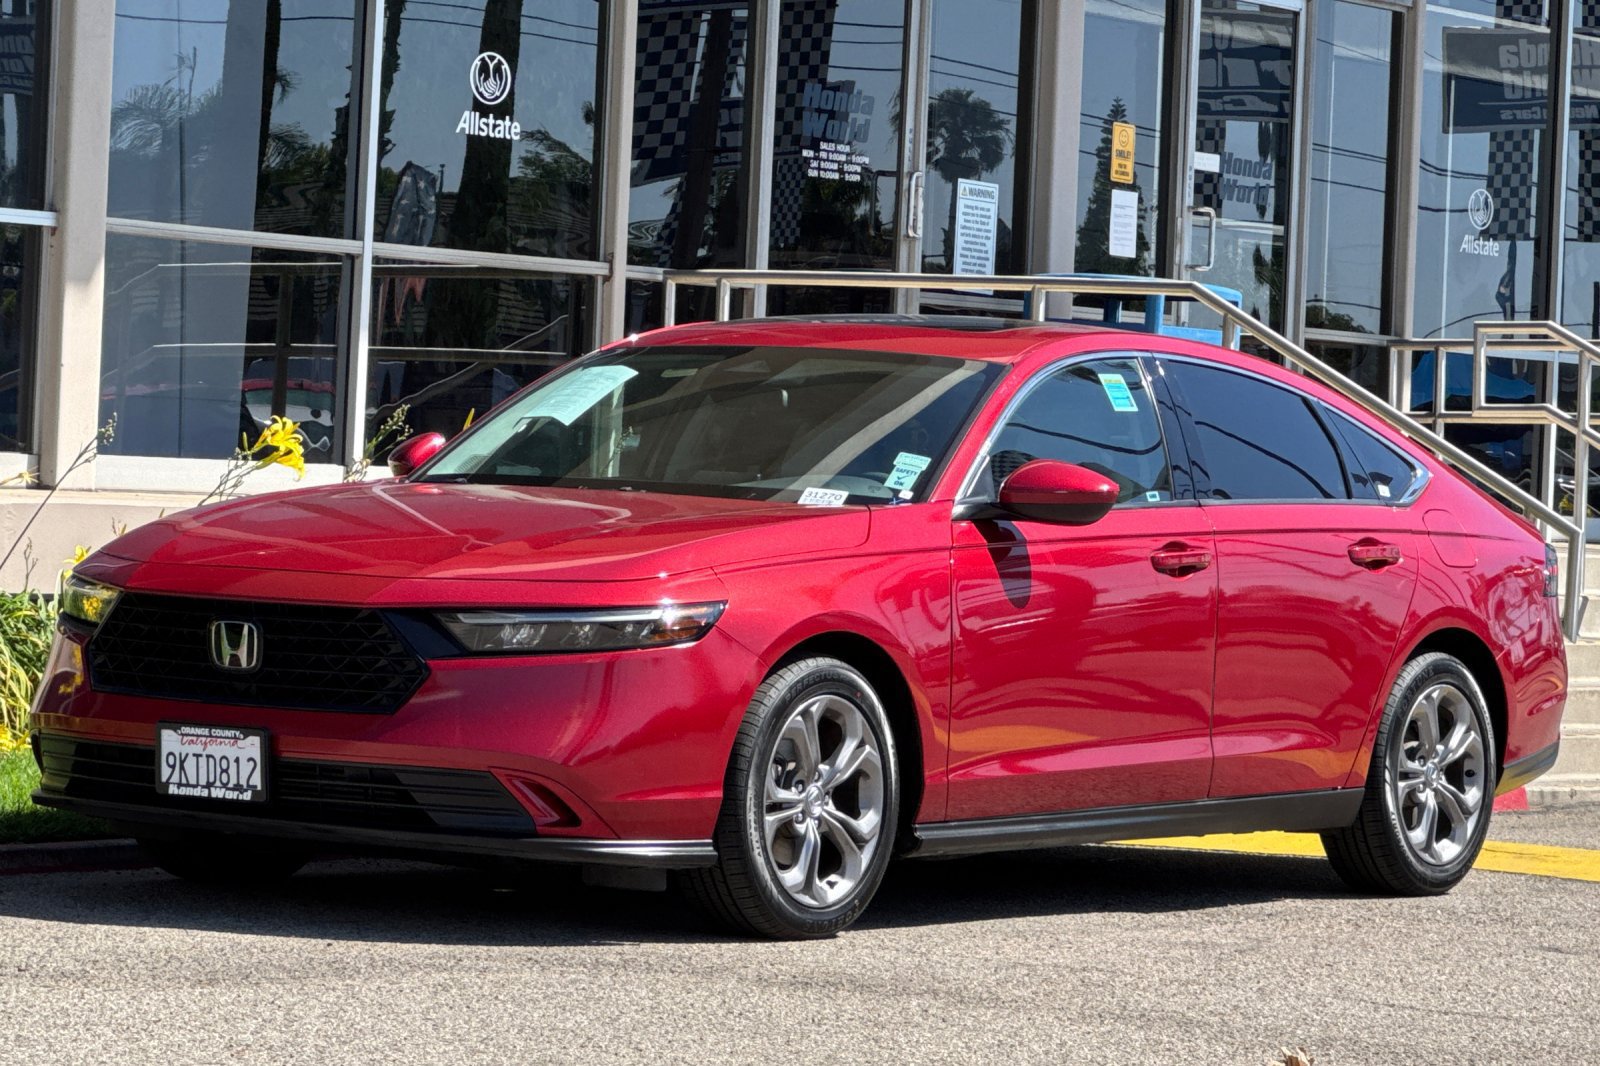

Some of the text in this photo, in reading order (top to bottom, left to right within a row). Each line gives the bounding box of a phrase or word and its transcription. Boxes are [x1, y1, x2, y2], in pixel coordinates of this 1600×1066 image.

[803, 82, 875, 115] Honda
[455, 110, 521, 140] Allstate
[803, 111, 871, 143] World
[820, 141, 836, 151] SALES
[802, 149, 814, 158] MON
[820, 151, 828, 159] FRI
[807, 168, 818, 178] SUN
[1220, 151, 1273, 181] Honda
[967, 186, 995, 200] WARNING
[1219, 177, 1270, 205] World
[1460, 234, 1500, 257] Allstate
[895, 466, 919, 476] SAFETY
[805, 490, 843, 501] 31270
[180, 726, 241, 738] ORANGE COUNTY
[181, 735, 245, 752] California
[165, 751, 258, 790] 9KTD812
[168, 784, 209, 798] Honda
